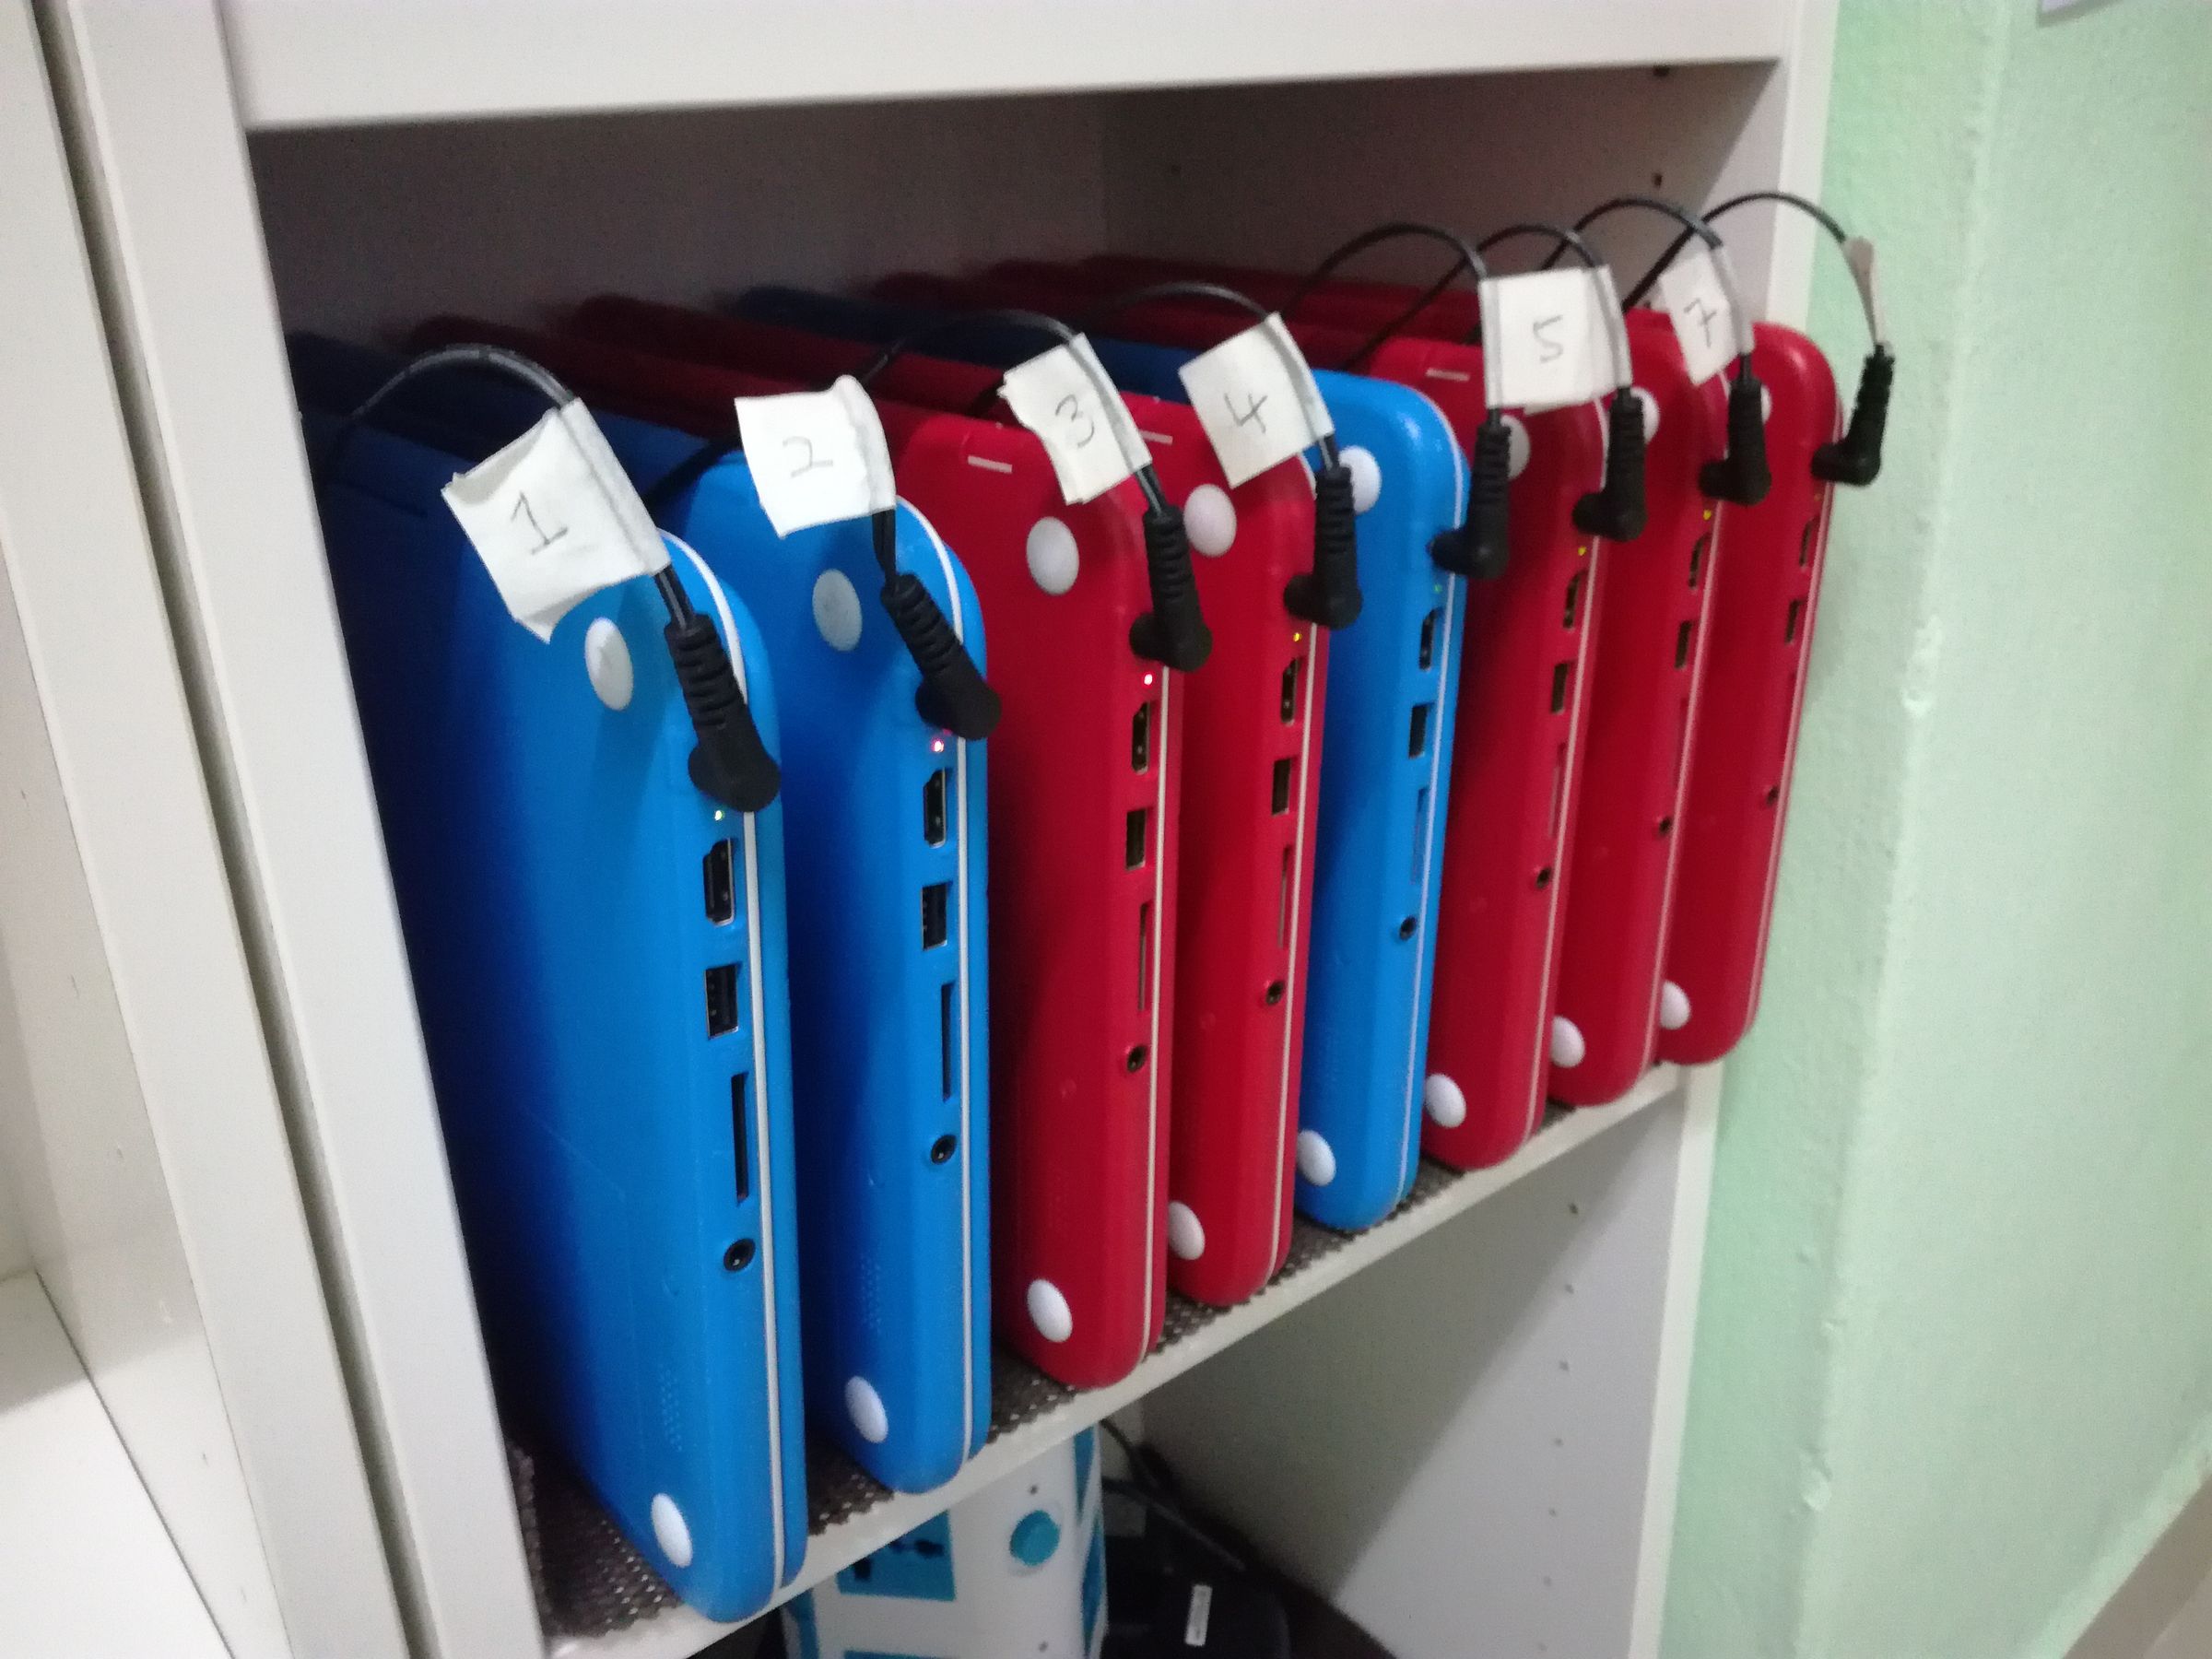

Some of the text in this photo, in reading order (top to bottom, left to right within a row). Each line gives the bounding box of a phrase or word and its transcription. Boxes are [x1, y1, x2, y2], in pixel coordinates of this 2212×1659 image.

[1532, 315, 1565, 363] 5
[1684, 298, 1717, 348] 7
[1054, 394, 1096, 449] 3
[1224, 392, 1268, 433] 4
[782, 436, 834, 477] 2
[511, 491, 568, 555] 1
